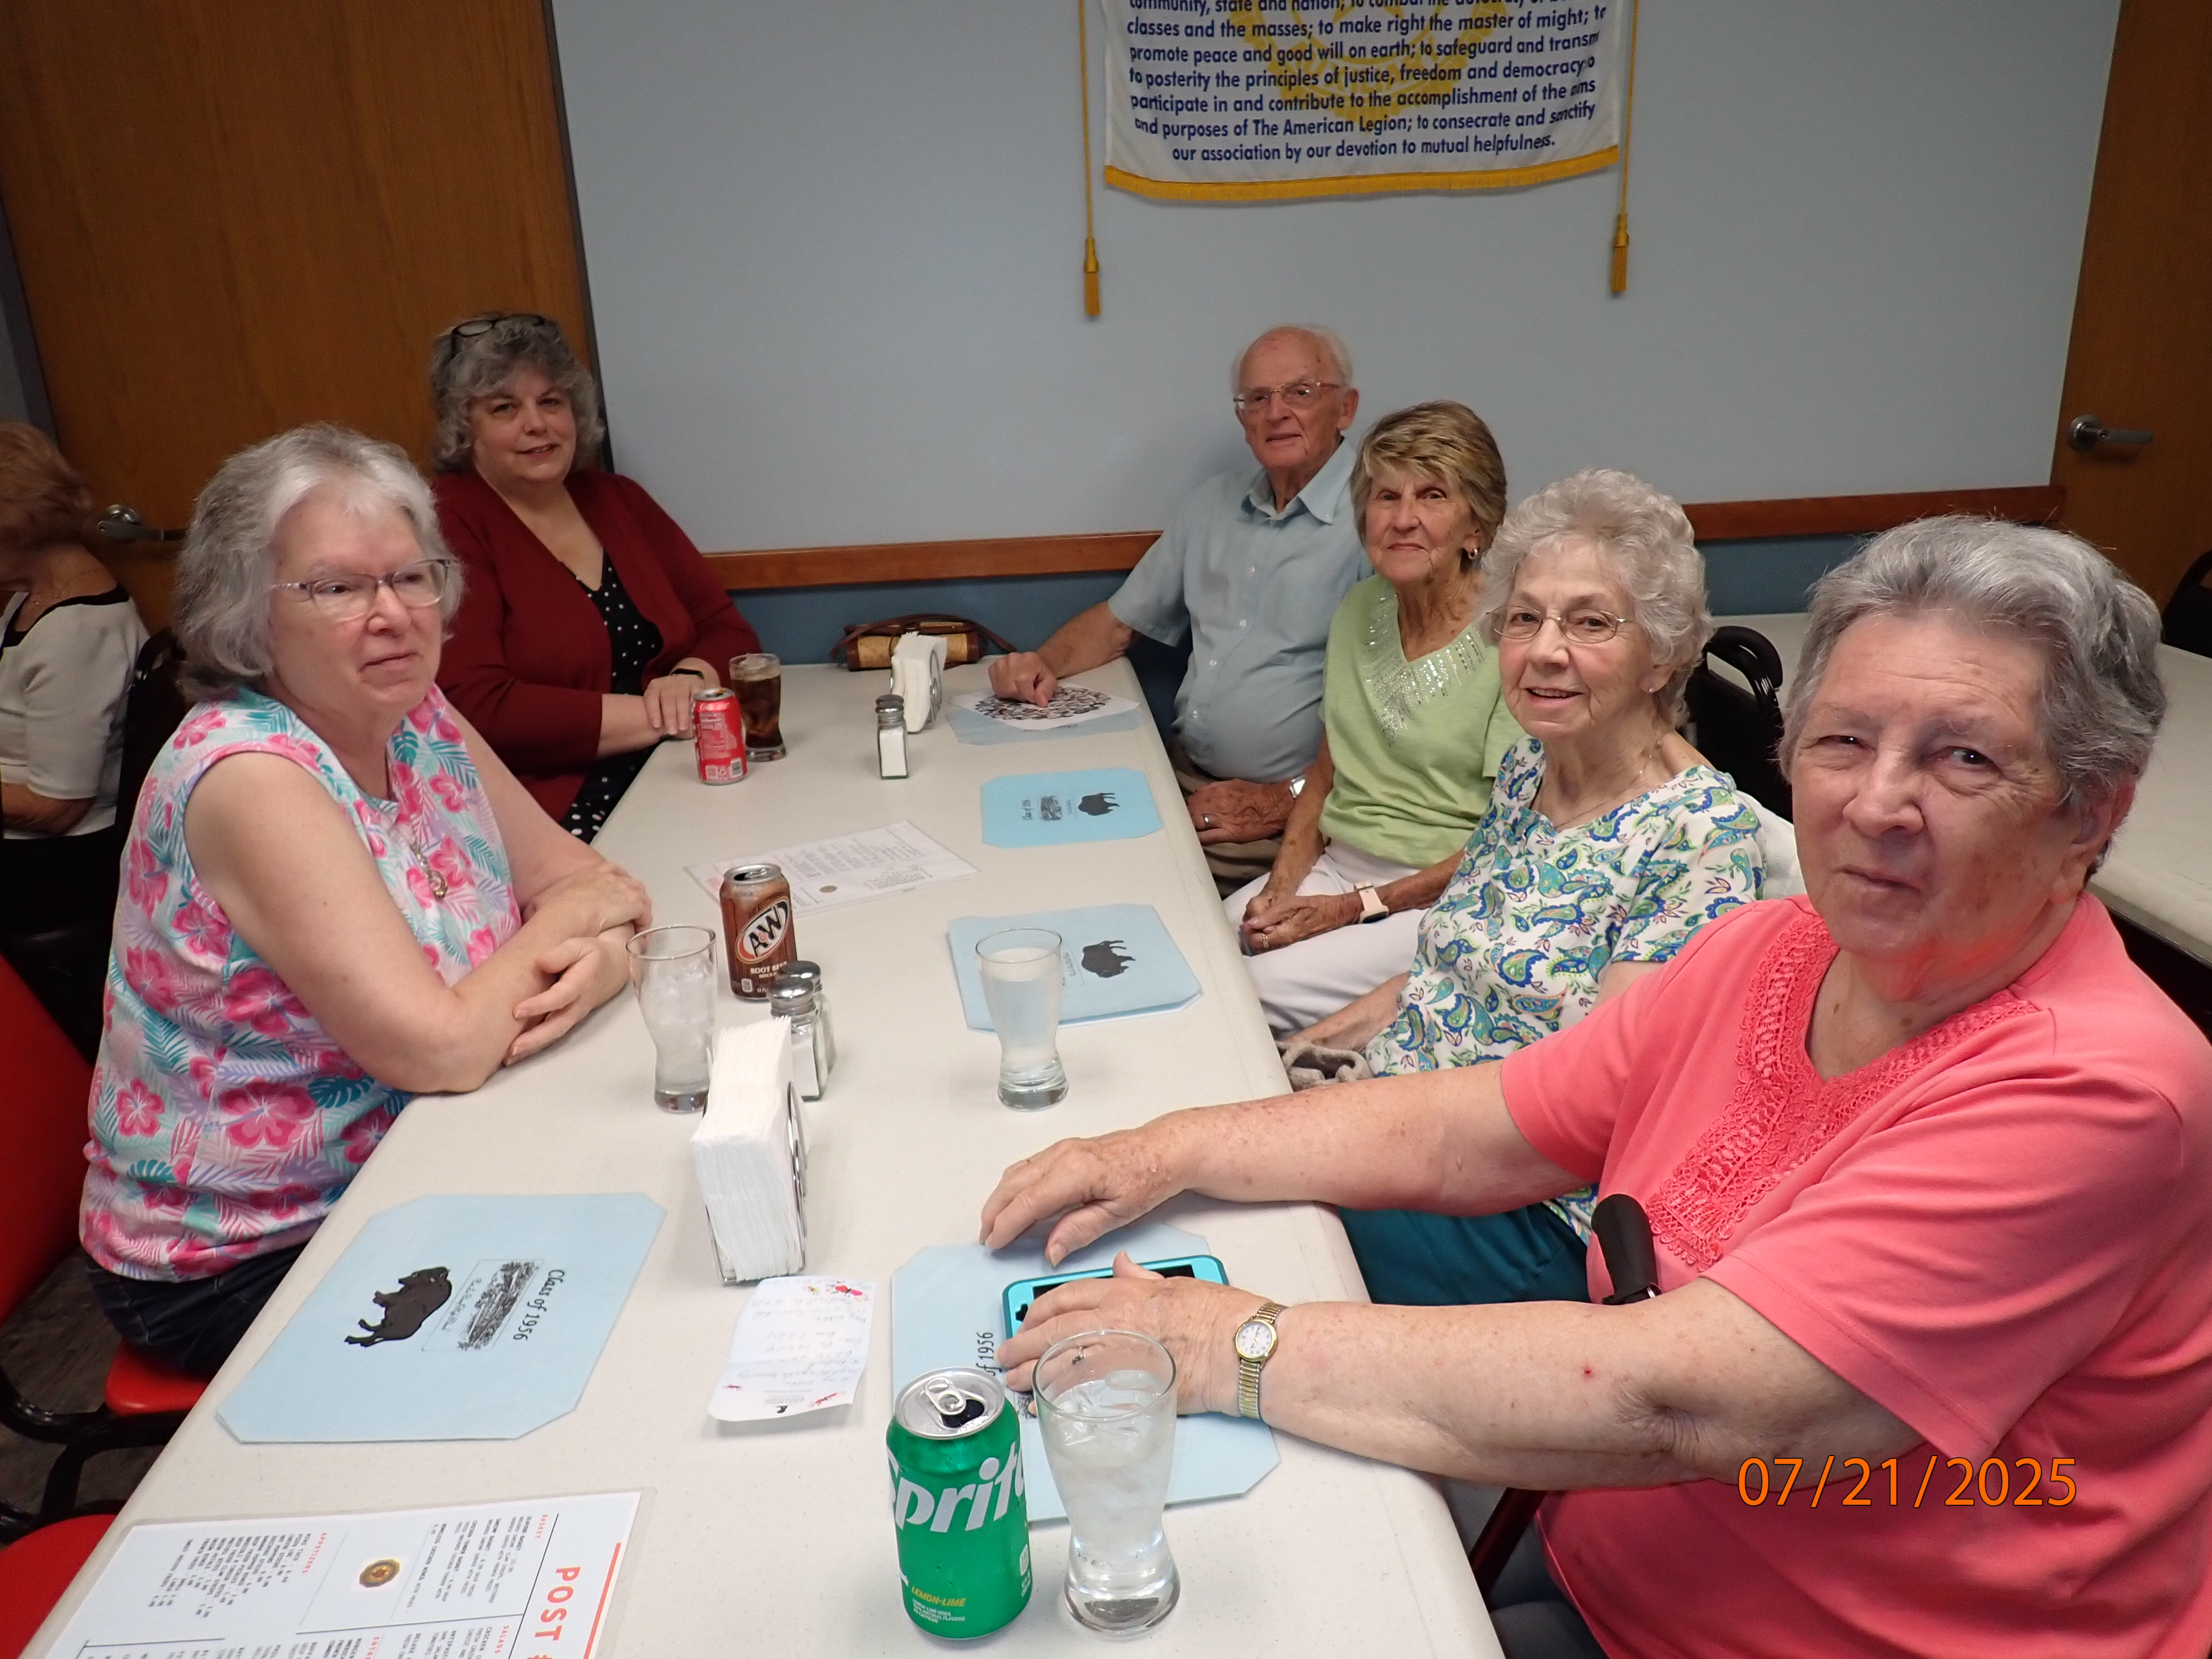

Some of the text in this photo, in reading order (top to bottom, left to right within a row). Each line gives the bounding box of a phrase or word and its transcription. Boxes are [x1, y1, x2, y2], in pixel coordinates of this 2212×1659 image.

[1127, 17, 1179, 36] classes
[1185, 20, 1214, 37] and
[1220, 19, 1245, 37] the
[1252, 22, 1313, 38] masses;
[1318, 19, 1333, 35] to
[1339, 15, 1381, 34] make
[1387, 14, 1426, 35] right
[1429, 13, 1452, 31] the
[1458, 13, 1514, 29] master
[1518, 11, 1532, 29] of
[1537, 8, 1589, 30] might;
[1130, 45, 1188, 63] promote
[1194, 49, 1238, 66] peace
[1243, 43, 1272, 61] and
[1277, 43, 1313, 65] good
[1317, 41, 1343, 59] will
[1348, 46, 1366, 58] on
[1371, 39, 1415, 59] earth;
[1420, 40, 1432, 56] to
[1436, 35, 1512, 59] safeguard
[1517, 35, 1544, 54] and
[1129, 67, 1142, 84] to
[1146, 69, 1211, 92] posterity
[1217, 70, 1240, 88] the
[1245, 69, 1319, 91] principles
[1324, 65, 1340, 85] of
[1344, 64, 1396, 87] justice,
[1400, 63, 1461, 82] freedom
[1467, 60, 1498, 80] and
[1503, 59, 1585, 79] democracy
[1131, 94, 1208, 116] participate
[1214, 96, 1228, 112] in
[1233, 94, 1263, 112] and
[1269, 91, 1345, 111] contribute
[1350, 90, 1364, 108] to
[1369, 89, 1391, 107] the
[1397, 87, 1517, 109] accomplishment
[1522, 84, 1538, 102] of
[1542, 81, 1566, 100] the
[1135, 117, 1158, 134] and
[1163, 122, 1228, 140] purposes
[1233, 118, 1248, 137] of
[1252, 119, 1278, 137] The
[1283, 117, 1354, 136] American
[1359, 114, 1412, 136] Legion;
[1417, 114, 1428, 130] to
[1432, 111, 1510, 130] consecrate
[1516, 108, 1546, 127] and
[1172, 133, 1555, 163] our association by our devotion to mutual helpfulness.
[748, 904, 782, 958] A&W
[513, 1270, 565, 1340] Class of 1956
[976, 1332, 994, 1360] 1956
[886, 1442, 1025, 1533] prit
[302, 1533, 327, 1573] APPETIZERS
[535, 1567, 581, 1641] POST
[912, 1586, 966, 1607] LEMON-LIME
[495, 1626, 508, 1652] SALADS
